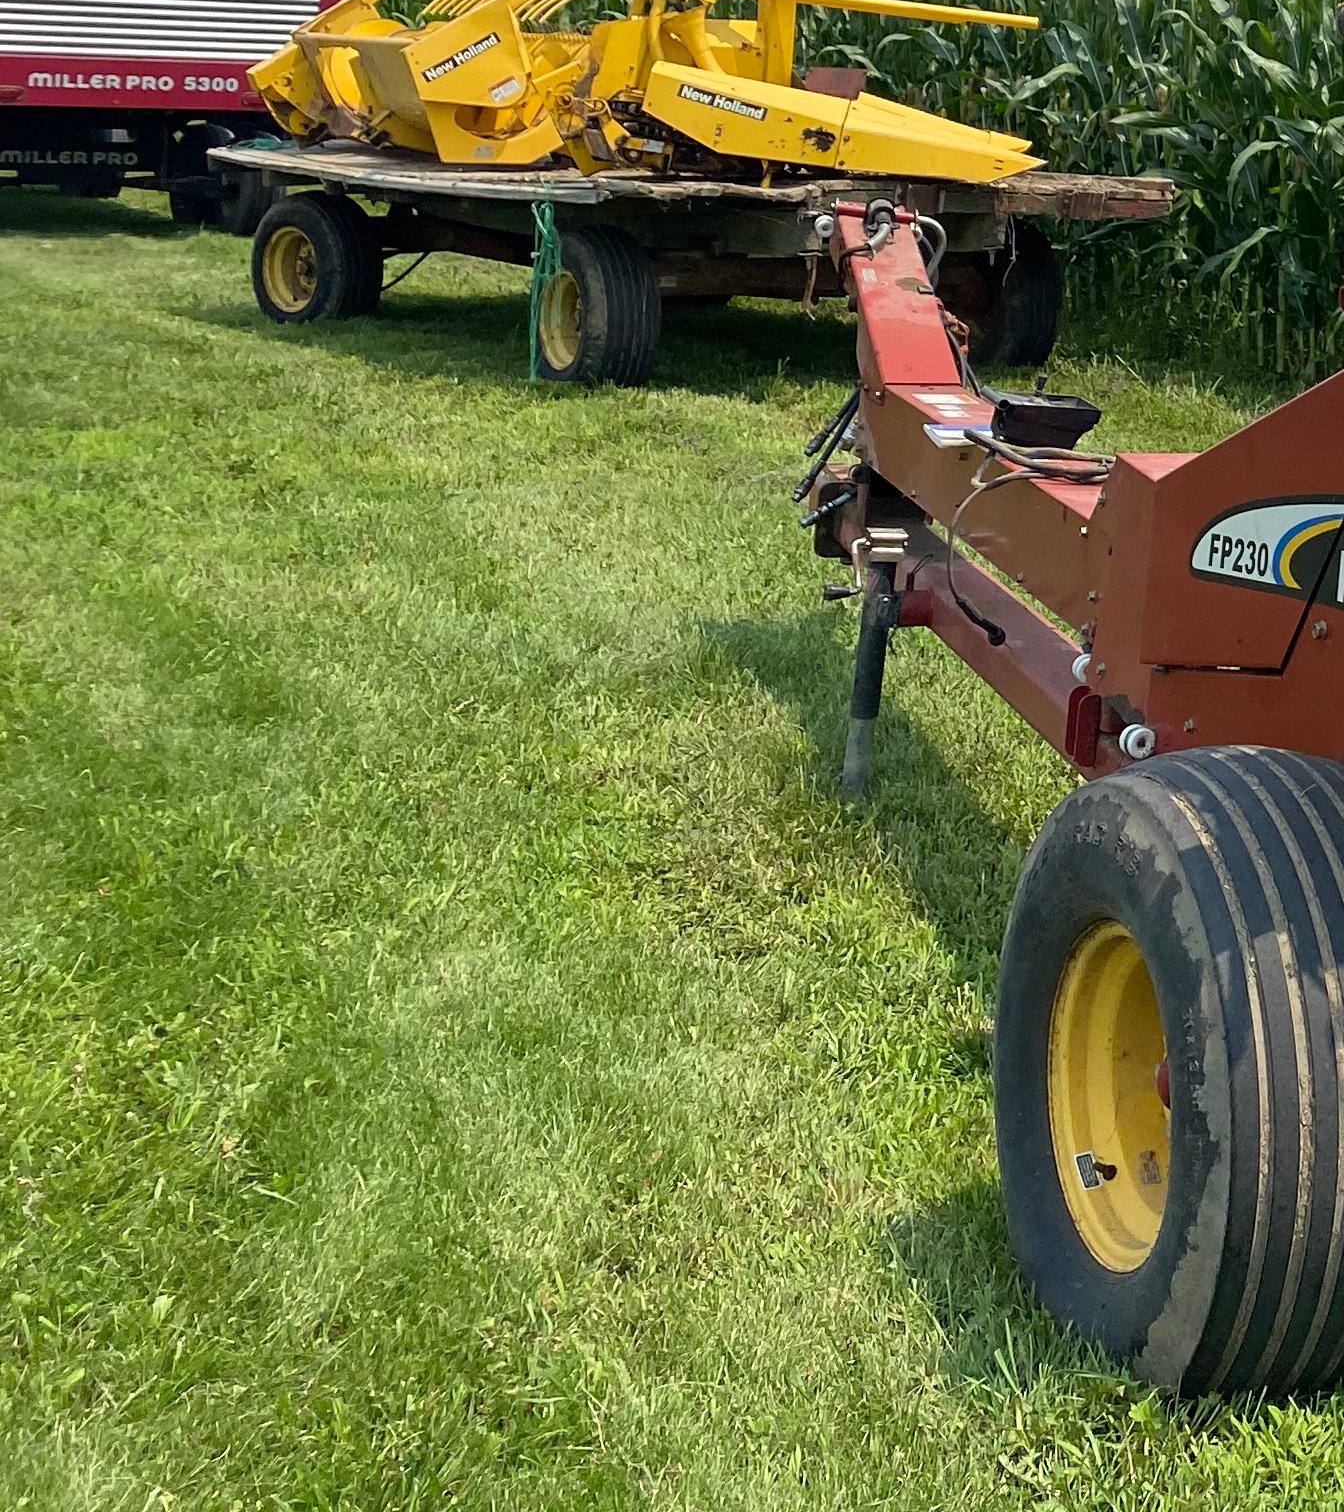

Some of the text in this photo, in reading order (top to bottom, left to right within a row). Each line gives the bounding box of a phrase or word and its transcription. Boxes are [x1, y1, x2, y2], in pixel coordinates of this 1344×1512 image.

[425, 34, 498, 81] New Holland
[28, 72, 239, 92] MILLER PRO 5300
[680, 84, 764, 120] New Holland
[0, 150, 138, 165] MILLER PRO
[1208, 533, 1269, 576] FP230
